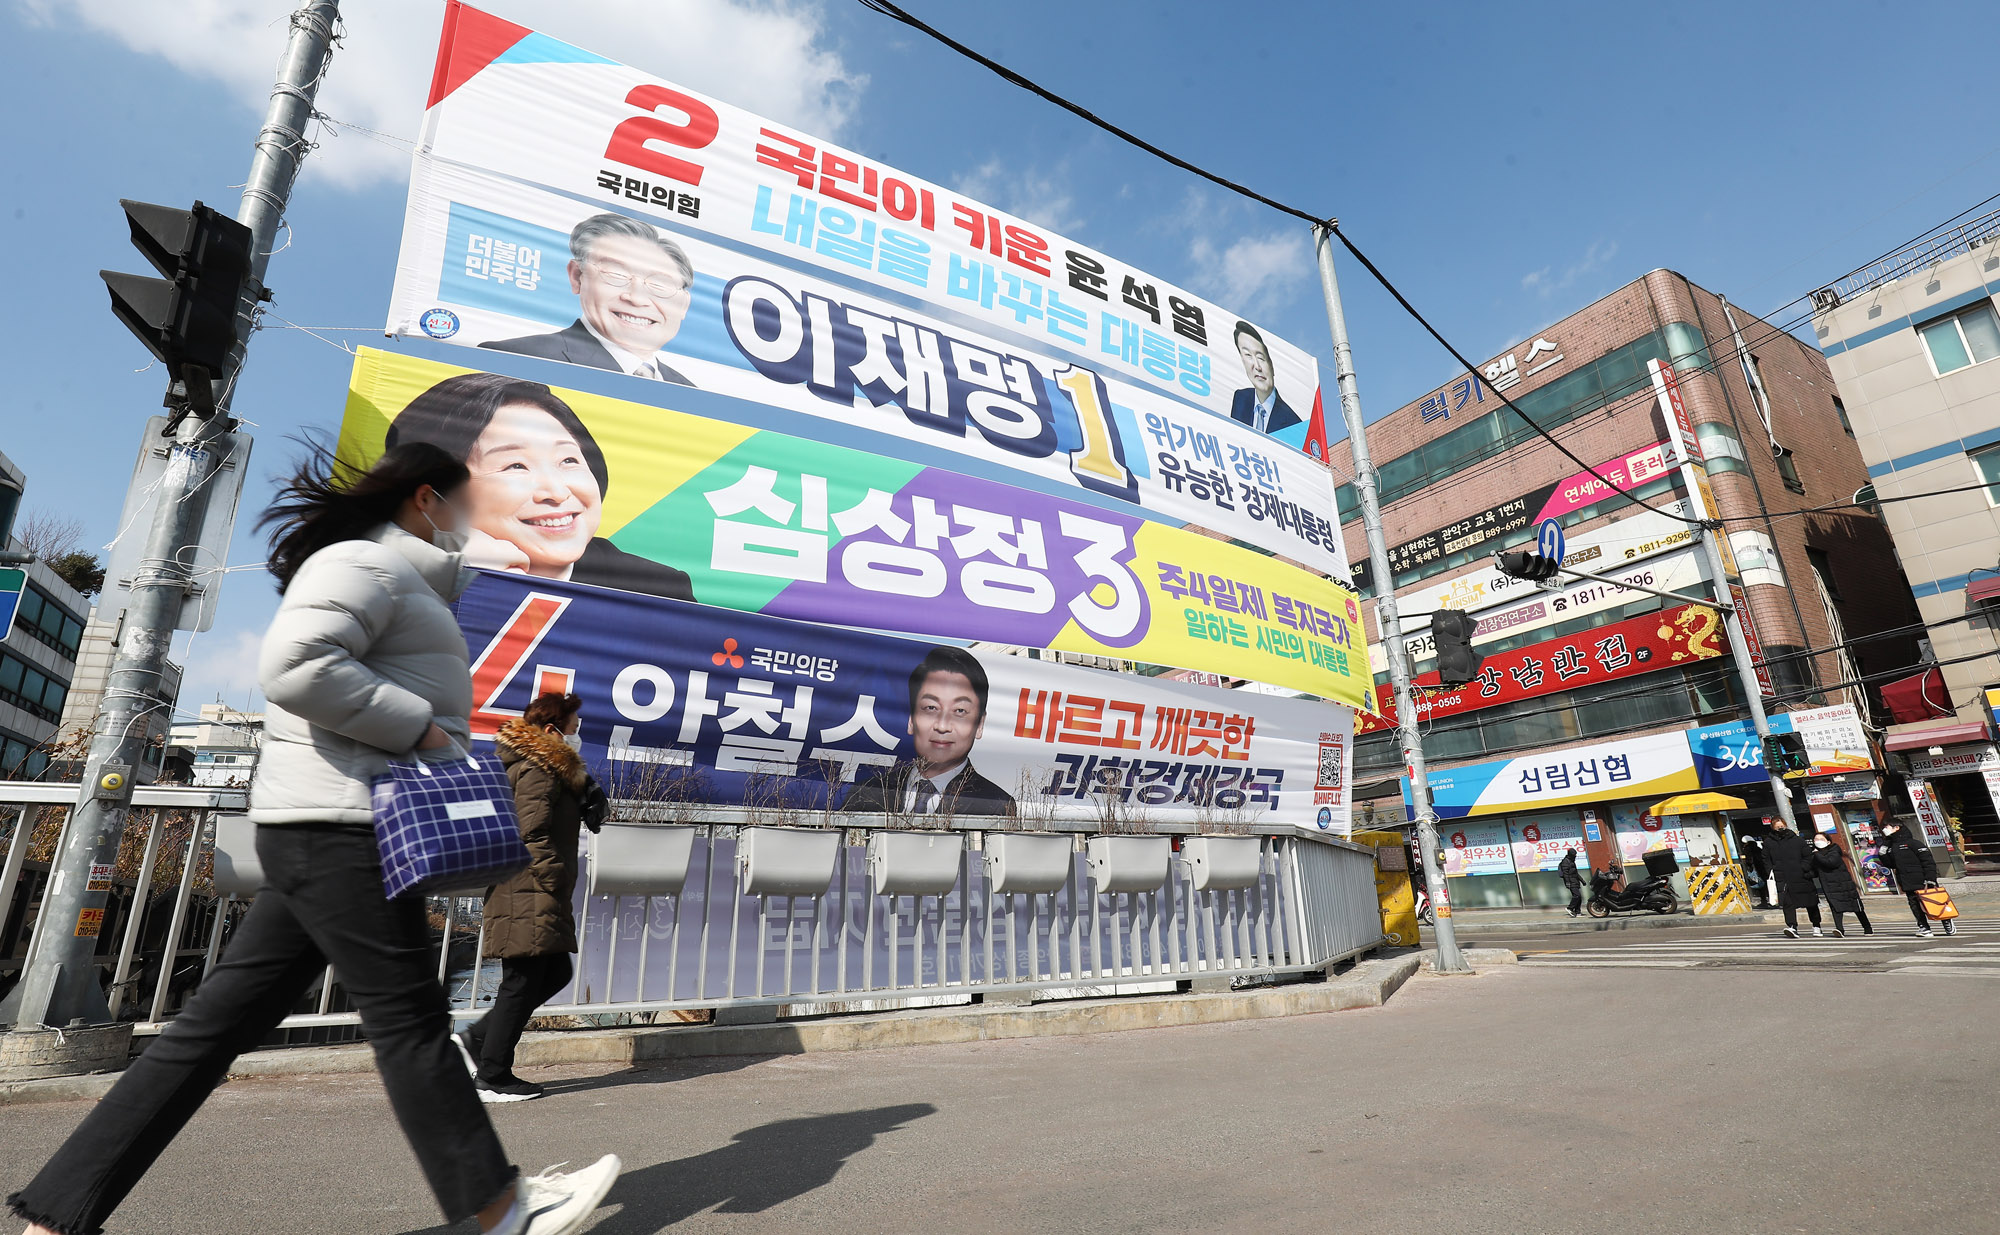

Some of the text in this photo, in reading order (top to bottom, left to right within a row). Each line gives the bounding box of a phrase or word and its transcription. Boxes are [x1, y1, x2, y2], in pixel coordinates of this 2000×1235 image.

[604, 84, 719, 186] 2
[597, 170, 700, 219] 국민의힘
[756, 127, 935, 231] 국민이
[952, 201, 1051, 277] 키운
[465, 255, 541, 291] 민주당
[467, 233, 541, 270] 더불어
[751, 185, 1212, 398] 내일을 바꾸는 대통령
[724, 276, 1136, 499] 이재명 1
[1418, 339, 1564, 424] 럭키헬스
[1145, 412, 1283, 493] 위기에 강한!
[1564, 449, 1679, 504] 연세에듀 플러스
[1158, 451, 1335, 554] 유능한 경제대통령
[1673, 501, 1688, 514] 3F
[1400, 535, 1436, 557] 실현하는
[1441, 521, 1472, 541] 관악구
[1475, 512, 1496, 528] 교육
[1498, 500, 1526, 518] 1번지
[1485, 516, 1527, 538] 889-6999
[1638, 530, 1690, 554] 1811-9296
[703, 465, 1145, 640] 심상정 3
[1562, 549, 1600, 568] 업연구소
[1157, 561, 1351, 649] 주4일제 복지국가
[1572, 571, 1653, 606] 1811-9296
[470, 591, 581, 741] 4
[750, 647, 839, 682] 국민의당
[1184, 608, 1351, 677] 일하는 시민의 대통령
[1476, 635, 1632, 698] 강남반점
[1637, 649, 1649, 660] 2F
[607, 663, 901, 783] 안철수
[1014, 687, 1255, 761] 바르고 깨끗한
[1708, 728, 1732, 739] 신림신협
[1817, 708, 1852, 720] 음악동아리
[1518, 753, 1631, 794] 신림신협
[1712, 741, 1763, 772] 365
[1913, 761, 1931, 770] 리집
[1931, 754, 1976, 768] 한식뷔페
[1041, 753, 1284, 811] 과학경제강국
[1313, 791, 1342, 806] AHNFLIX
[1912, 789, 1940, 836] 한식뷔페
[1463, 846, 1506, 860] 최우수상
[1537, 840, 1586, 854] 최우수상
